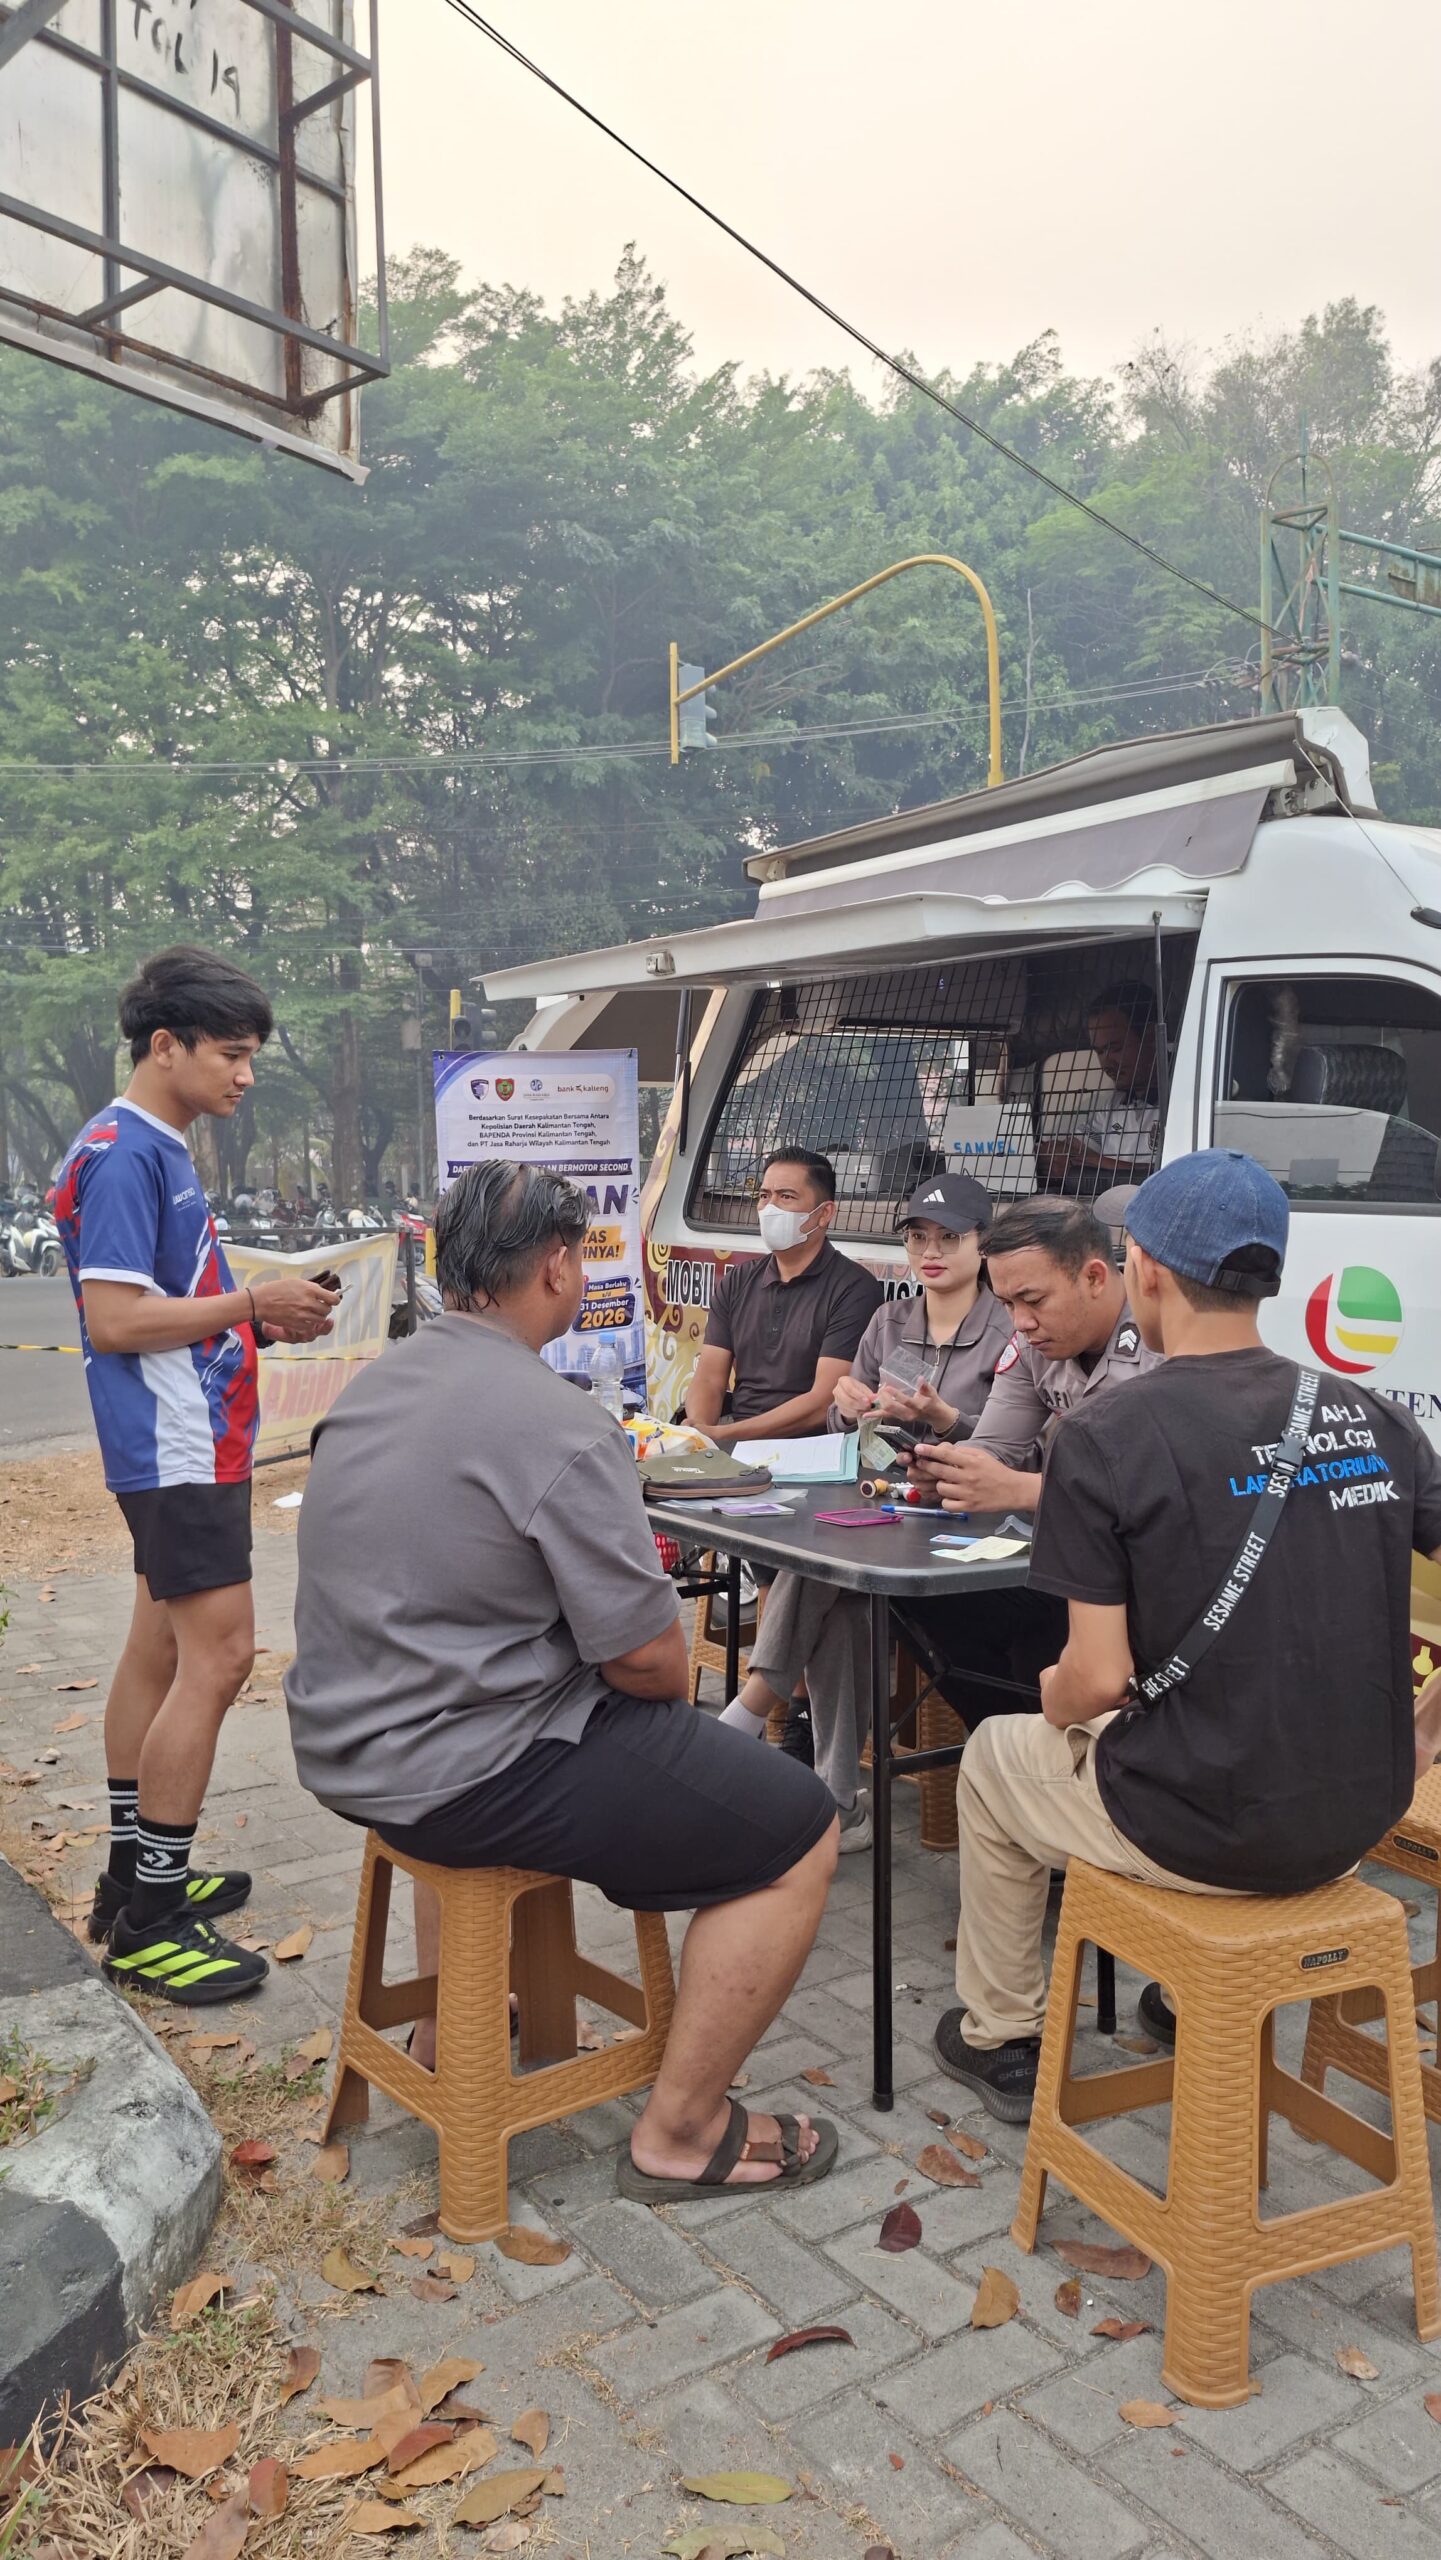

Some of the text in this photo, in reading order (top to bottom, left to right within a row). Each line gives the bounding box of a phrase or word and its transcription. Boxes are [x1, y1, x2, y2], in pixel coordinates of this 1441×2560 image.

[524, 1114, 563, 1122] Kesepakatan
[573, 1121, 596, 1129] Tengah,
[574, 1130, 597, 1138] Tengah,
[504, 1140, 528, 1148] Raharja
[528, 1140, 554, 1148] Wilayah
[589, 1139, 611, 1147] Tengah
[558, 1163, 598, 1172] BERMOTOR
[599, 1162, 629, 1171] SECOND
[588, 1280, 628, 1291] Masa Berlaku
[580, 1299, 629, 1311] 31 Desember
[580, 1307, 626, 1329] 2026
[1296, 1370, 1320, 1405] STREET
[1321, 1404, 1367, 1423] AHLI
[1329, 1480, 1401, 1511] MEDIK
[1203, 1531, 1267, 1631] SESAME STREET
[998, 2067, 1035, 2083] SKEC
